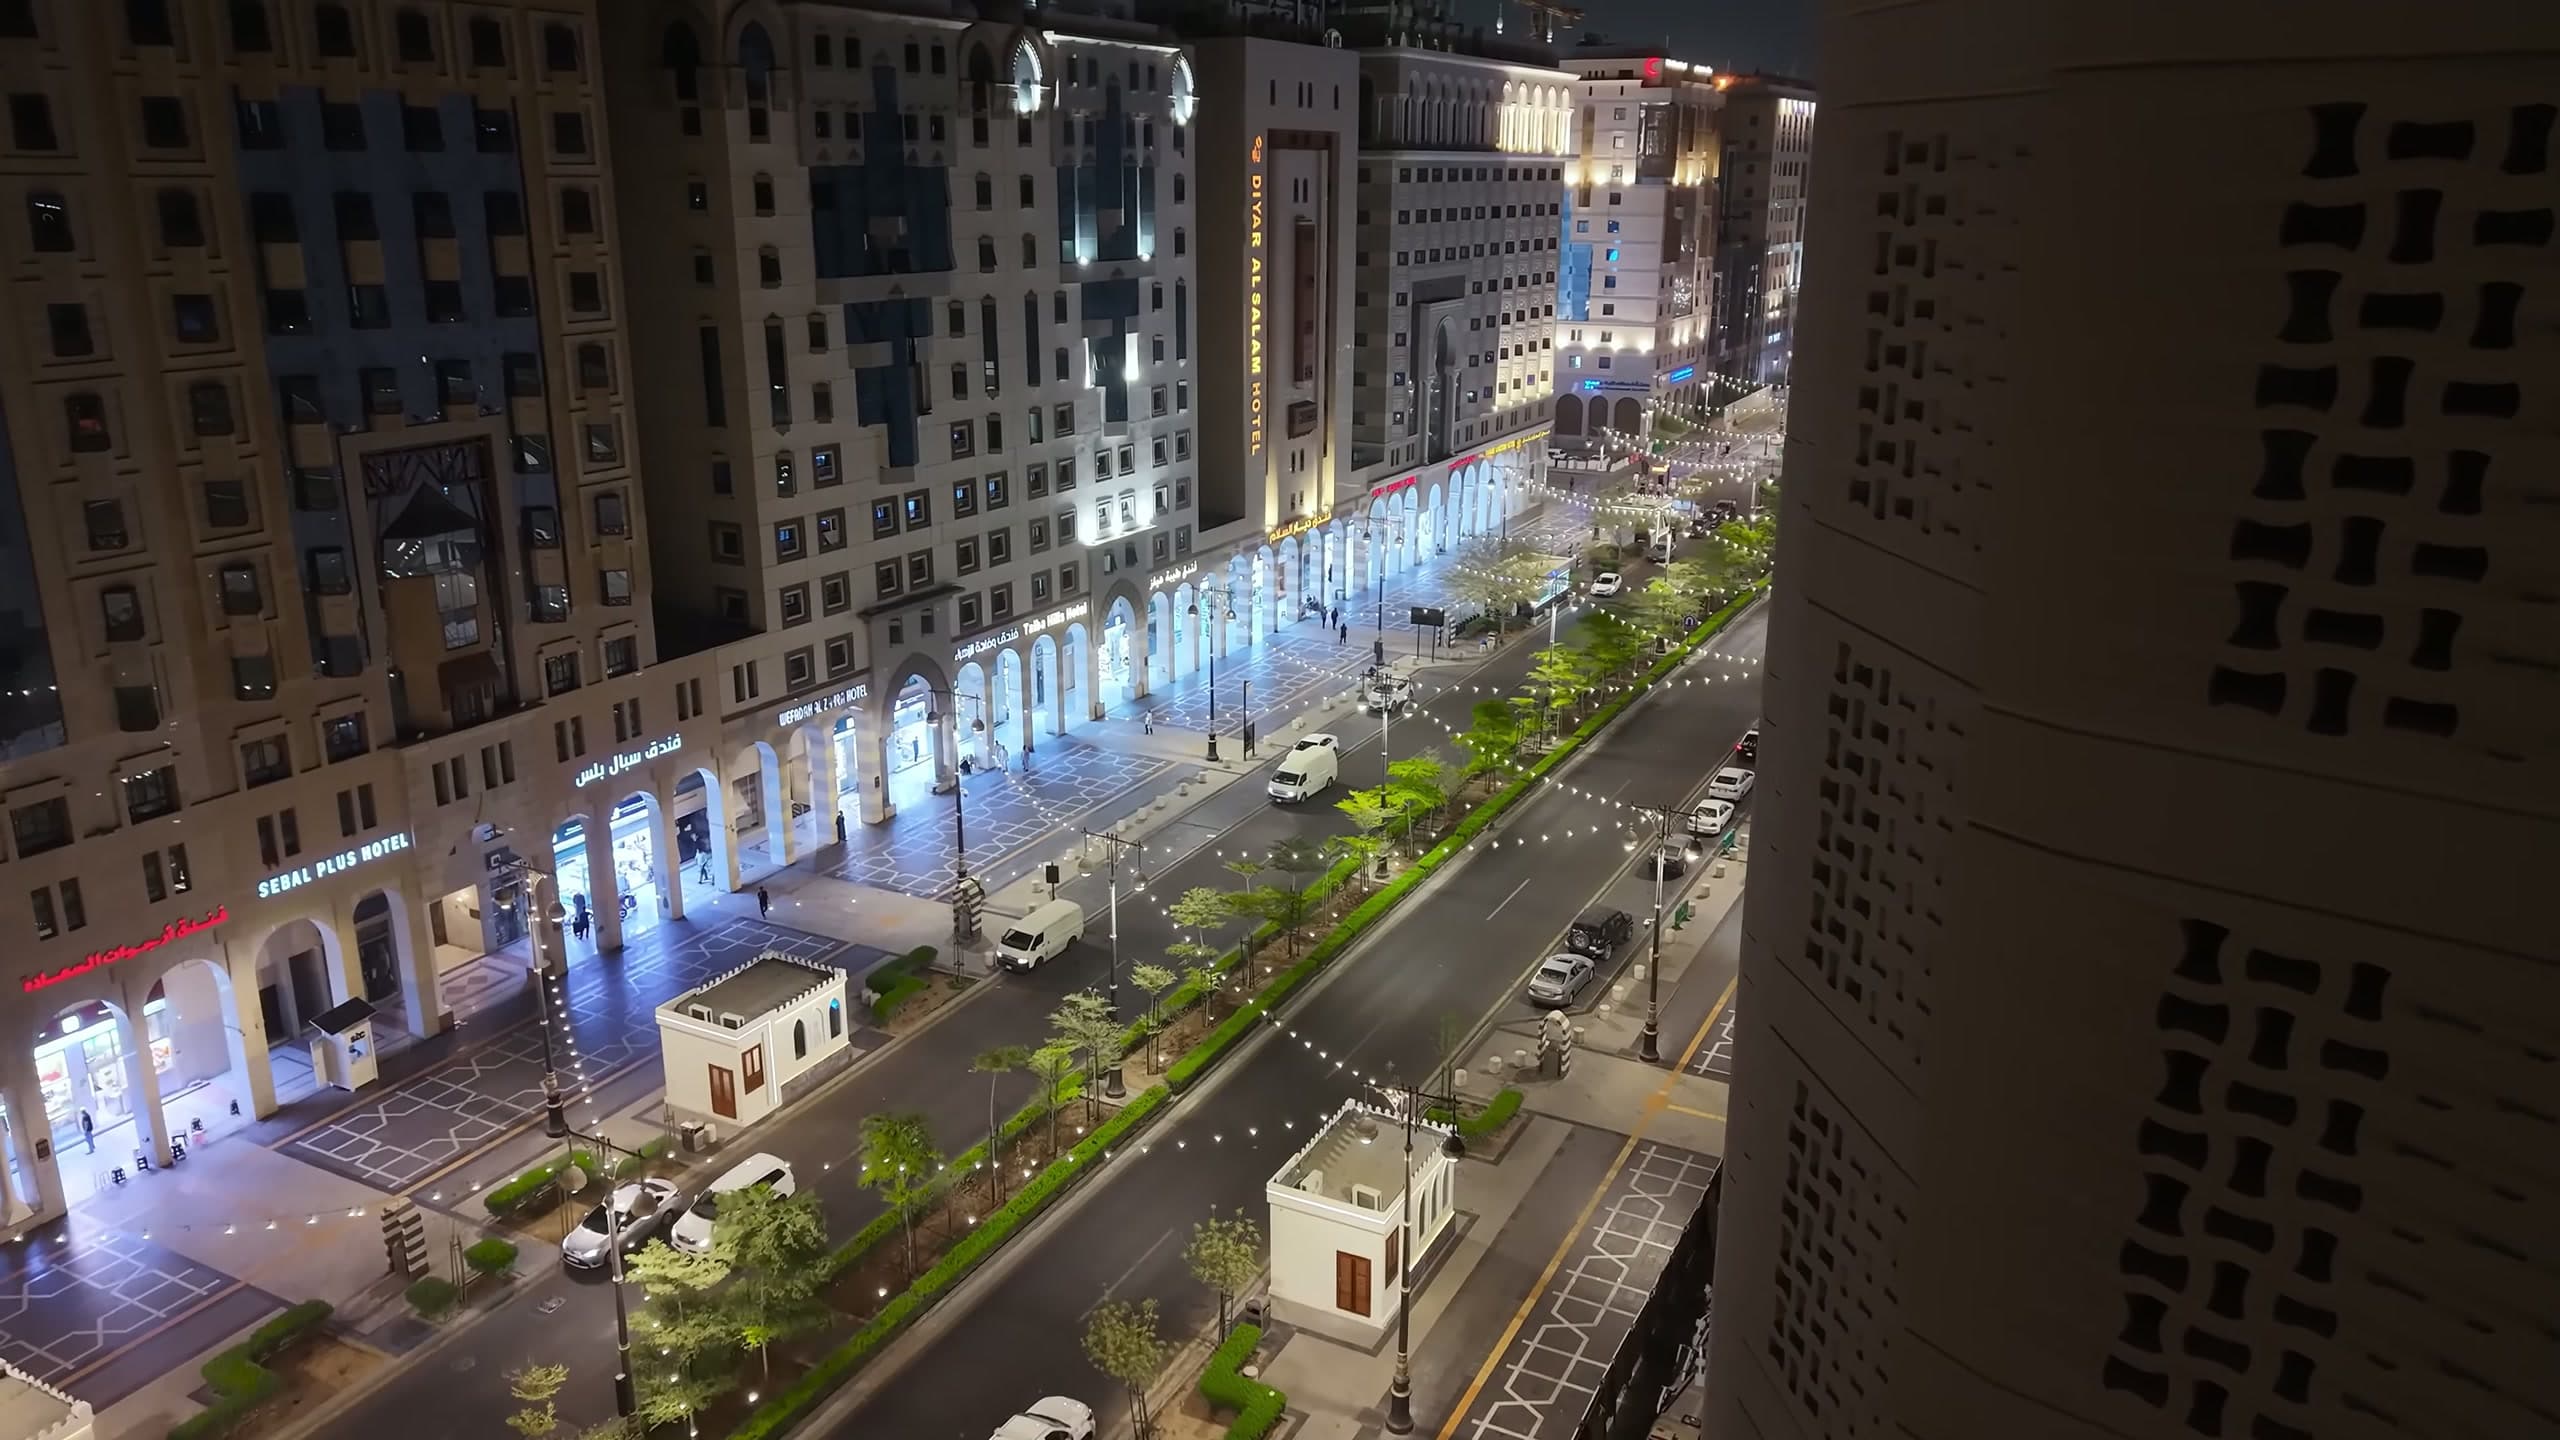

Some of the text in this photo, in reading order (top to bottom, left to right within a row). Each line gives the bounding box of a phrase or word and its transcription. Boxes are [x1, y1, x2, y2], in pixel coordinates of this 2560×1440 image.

[1251, 175, 1262, 248] DIYAR
[1251, 382, 1261, 456] HOTEL
[1065, 601, 1088, 621] Hotel
[997, 627, 1019, 645] فندق
[846, 683, 868, 703] HOTEL
[575, 732, 682, 788] فندق سبال بلس
[257, 832, 409, 899] SEBAL PLUS HOTEL
[176, 904, 229, 940] فندق
